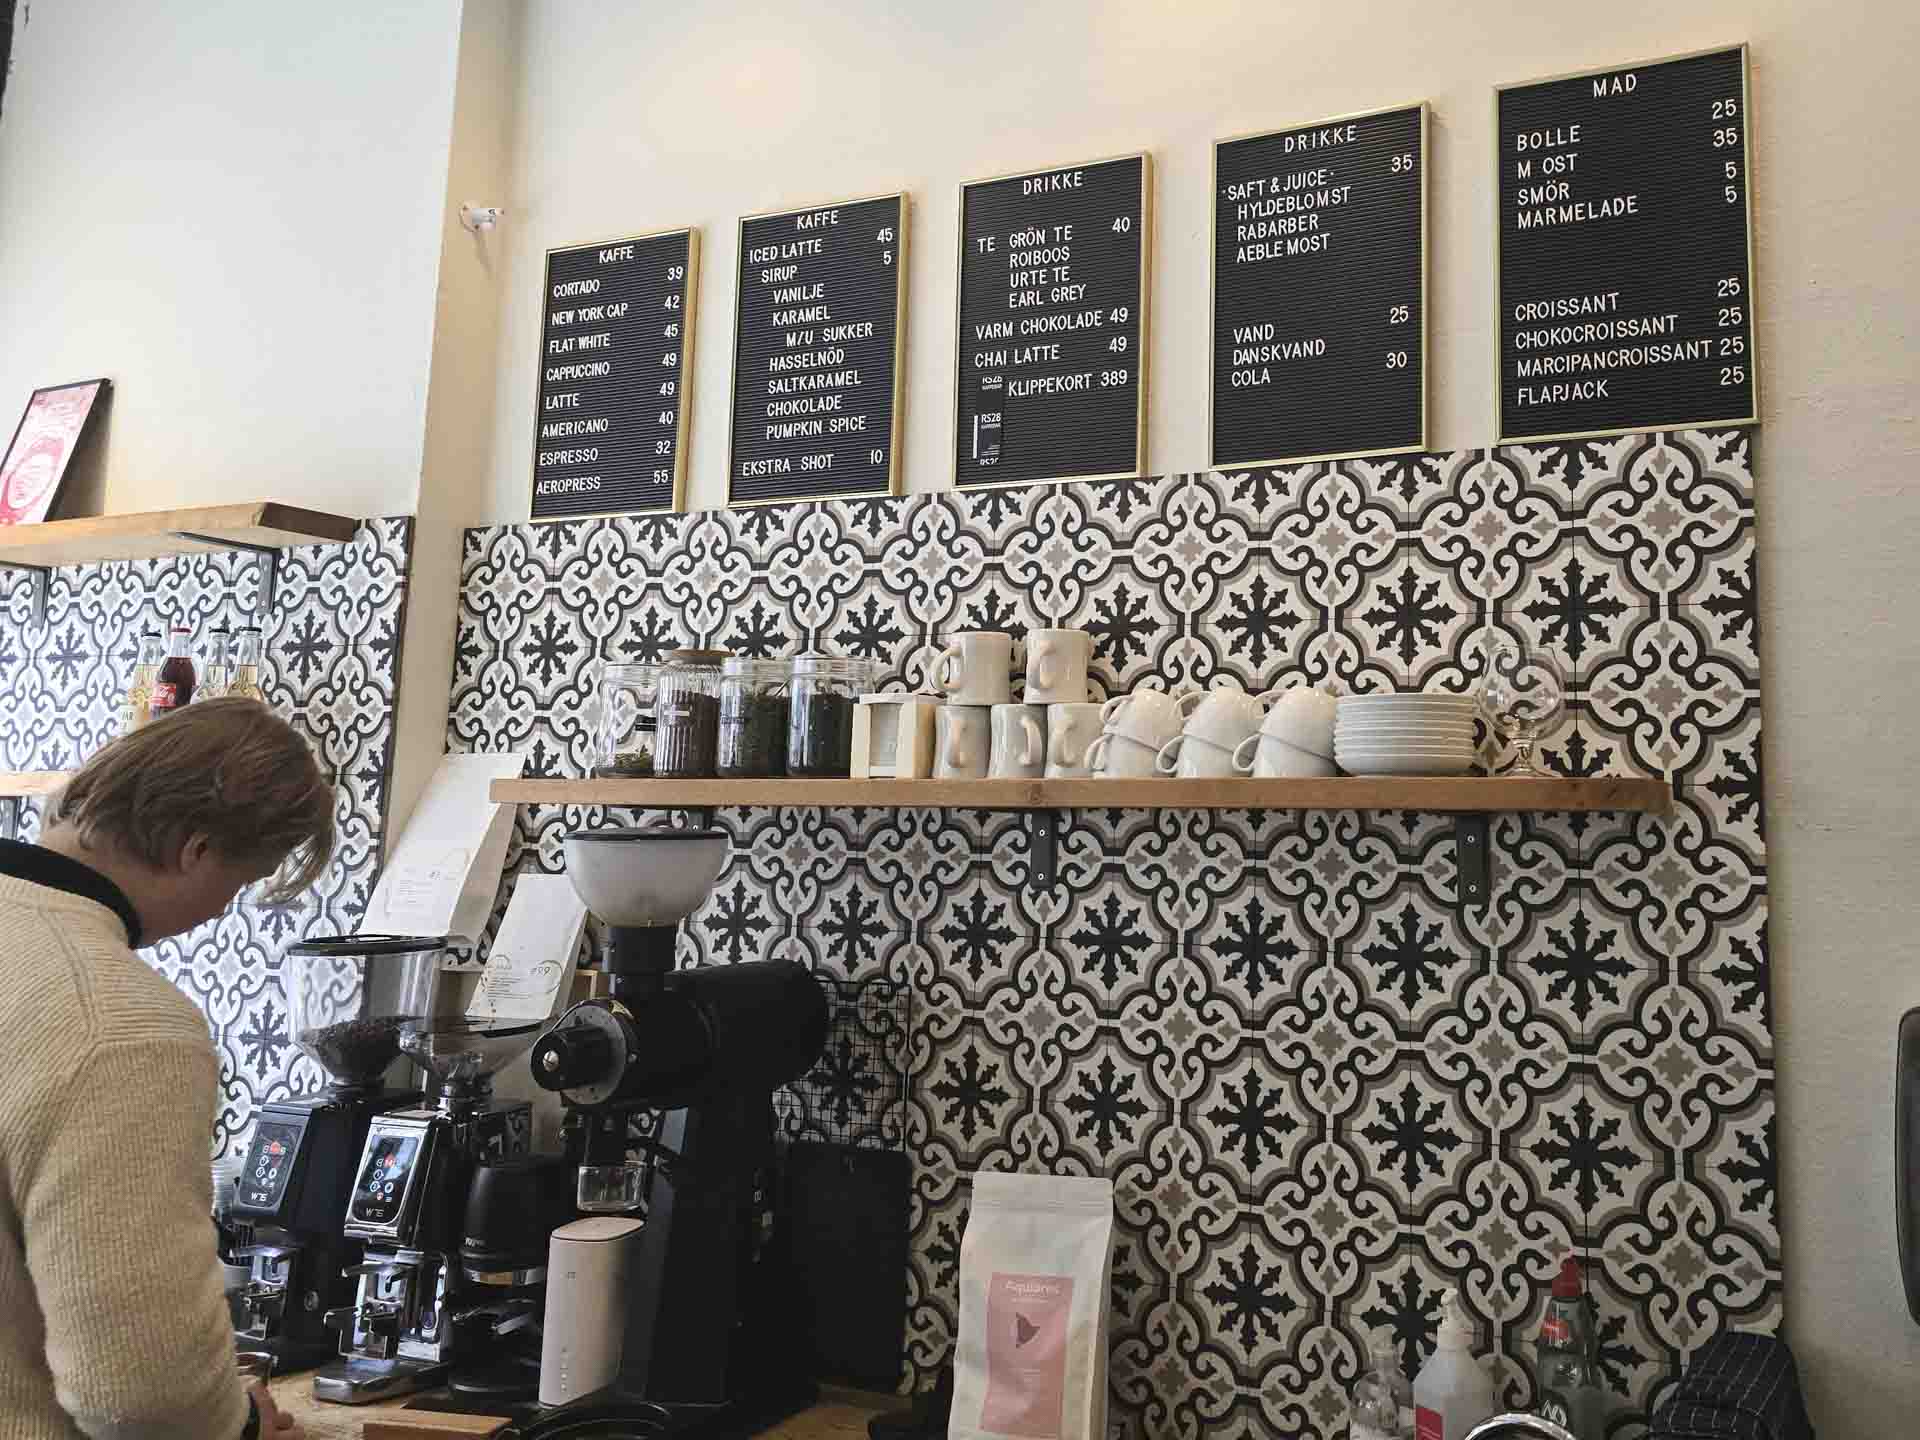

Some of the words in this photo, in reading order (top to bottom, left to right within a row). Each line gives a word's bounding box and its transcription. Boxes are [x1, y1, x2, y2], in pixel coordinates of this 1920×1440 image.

[1593, 73, 1637, 98] MAD
[1711, 98, 1737, 120] 25
[1284, 124, 1357, 153] DRIKKE
[1517, 124, 1581, 152] BOLLE
[1713, 127, 1738, 148] 35
[1391, 153, 1413, 173] 35
[1517, 159, 1531, 179] M
[1542, 153, 1578, 175] OST
[1725, 161, 1737, 180] 5
[1023, 171, 1083, 196] DRIKKE
[1270, 176, 1281, 194] &
[1517, 179, 1570, 206] SMÖR
[1236, 187, 1351, 221] HYLDEBLOMST
[1725, 185, 1738, 204] 5
[796, 209, 839, 230] KAFFE
[1517, 195, 1639, 229] MARMELADE
[1111, 216, 1131, 233] 40
[1237, 213, 1319, 242] RABARBER
[876, 227, 893, 244] 45
[976, 236, 996, 254] TE
[1009, 226, 1046, 249] GRÖN
[1053, 224, 1073, 243] TE
[599, 245, 635, 264] KAFFE
[749, 245, 779, 264] ICED
[781, 238, 823, 259] LATTE
[883, 250, 892, 266] 5
[1009, 245, 1071, 269] ROIBOOS
[1236, 240, 1284, 264] AEBLE
[1286, 232, 1331, 256] MOST
[667, 265, 684, 281] 39
[761, 264, 798, 284] SIRUP
[1010, 268, 1048, 289] URTE
[1052, 265, 1071, 283] TE
[553, 278, 601, 298] CORTADO
[772, 282, 825, 304] VANILJE
[1009, 290, 1044, 309] EARL
[1050, 283, 1087, 303] GREY
[1717, 277, 1741, 297] 25
[663, 294, 680, 310] 42
[1514, 292, 1620, 321] CROISSANT
[551, 310, 576, 326] NEW
[577, 305, 605, 322] YORK
[606, 302, 629, 318] CAP
[772, 305, 831, 327] KARAMEL
[1109, 307, 1129, 324] 49
[1390, 305, 1409, 324] 25
[1718, 306, 1742, 327] 25
[663, 323, 679, 338] 45
[786, 329, 814, 347] M/U
[822, 321, 873, 342] SUKKER
[975, 321, 1014, 341] VARM
[1020, 310, 1103, 335] CHOKOLADE
[1233, 323, 1275, 345] VAND
[1515, 314, 1678, 350] CHOKOCROISSANT
[549, 337, 576, 354] FLAT
[578, 332, 611, 350] WHITE
[1108, 335, 1128, 353] 49
[1233, 338, 1326, 366] DANSKVAND
[1720, 336, 1745, 356] 25
[661, 352, 677, 367] 49
[768, 346, 845, 372] HASSELNÖD
[974, 350, 1007, 369] CHAI
[1014, 343, 1060, 365] LATTE
[1385, 351, 1408, 369] 30
[1517, 339, 1713, 378] MARCIPANCROISSANT
[546, 361, 610, 382] CAPPUCCINO
[767, 369, 862, 395] SALTKARAMEL
[1100, 369, 1128, 387] 389
[1231, 367, 1271, 388] COLA
[1720, 366, 1745, 386] 25
[659, 381, 675, 397] 49
[1008, 373, 1093, 397] KLIPPEKORT
[1518, 379, 1609, 406] FLAPJACK
[545, 392, 580, 410] LATTE
[766, 394, 843, 417] CHOKOLADE
[541, 417, 609, 438] AMERICANO
[658, 410, 674, 425] 40
[981, 412, 1002, 424] RS28
[765, 419, 823, 442] PUMPKIN
[829, 415, 867, 433] SPICE
[539, 447, 599, 467] ESPRESSO
[655, 439, 671, 454] 32
[870, 449, 884, 465] 10
[742, 457, 791, 476] EKSTRA
[800, 453, 835, 471] SHOT
[535, 475, 601, 496] AEROPRESS
[653, 469, 669, 484] 55
